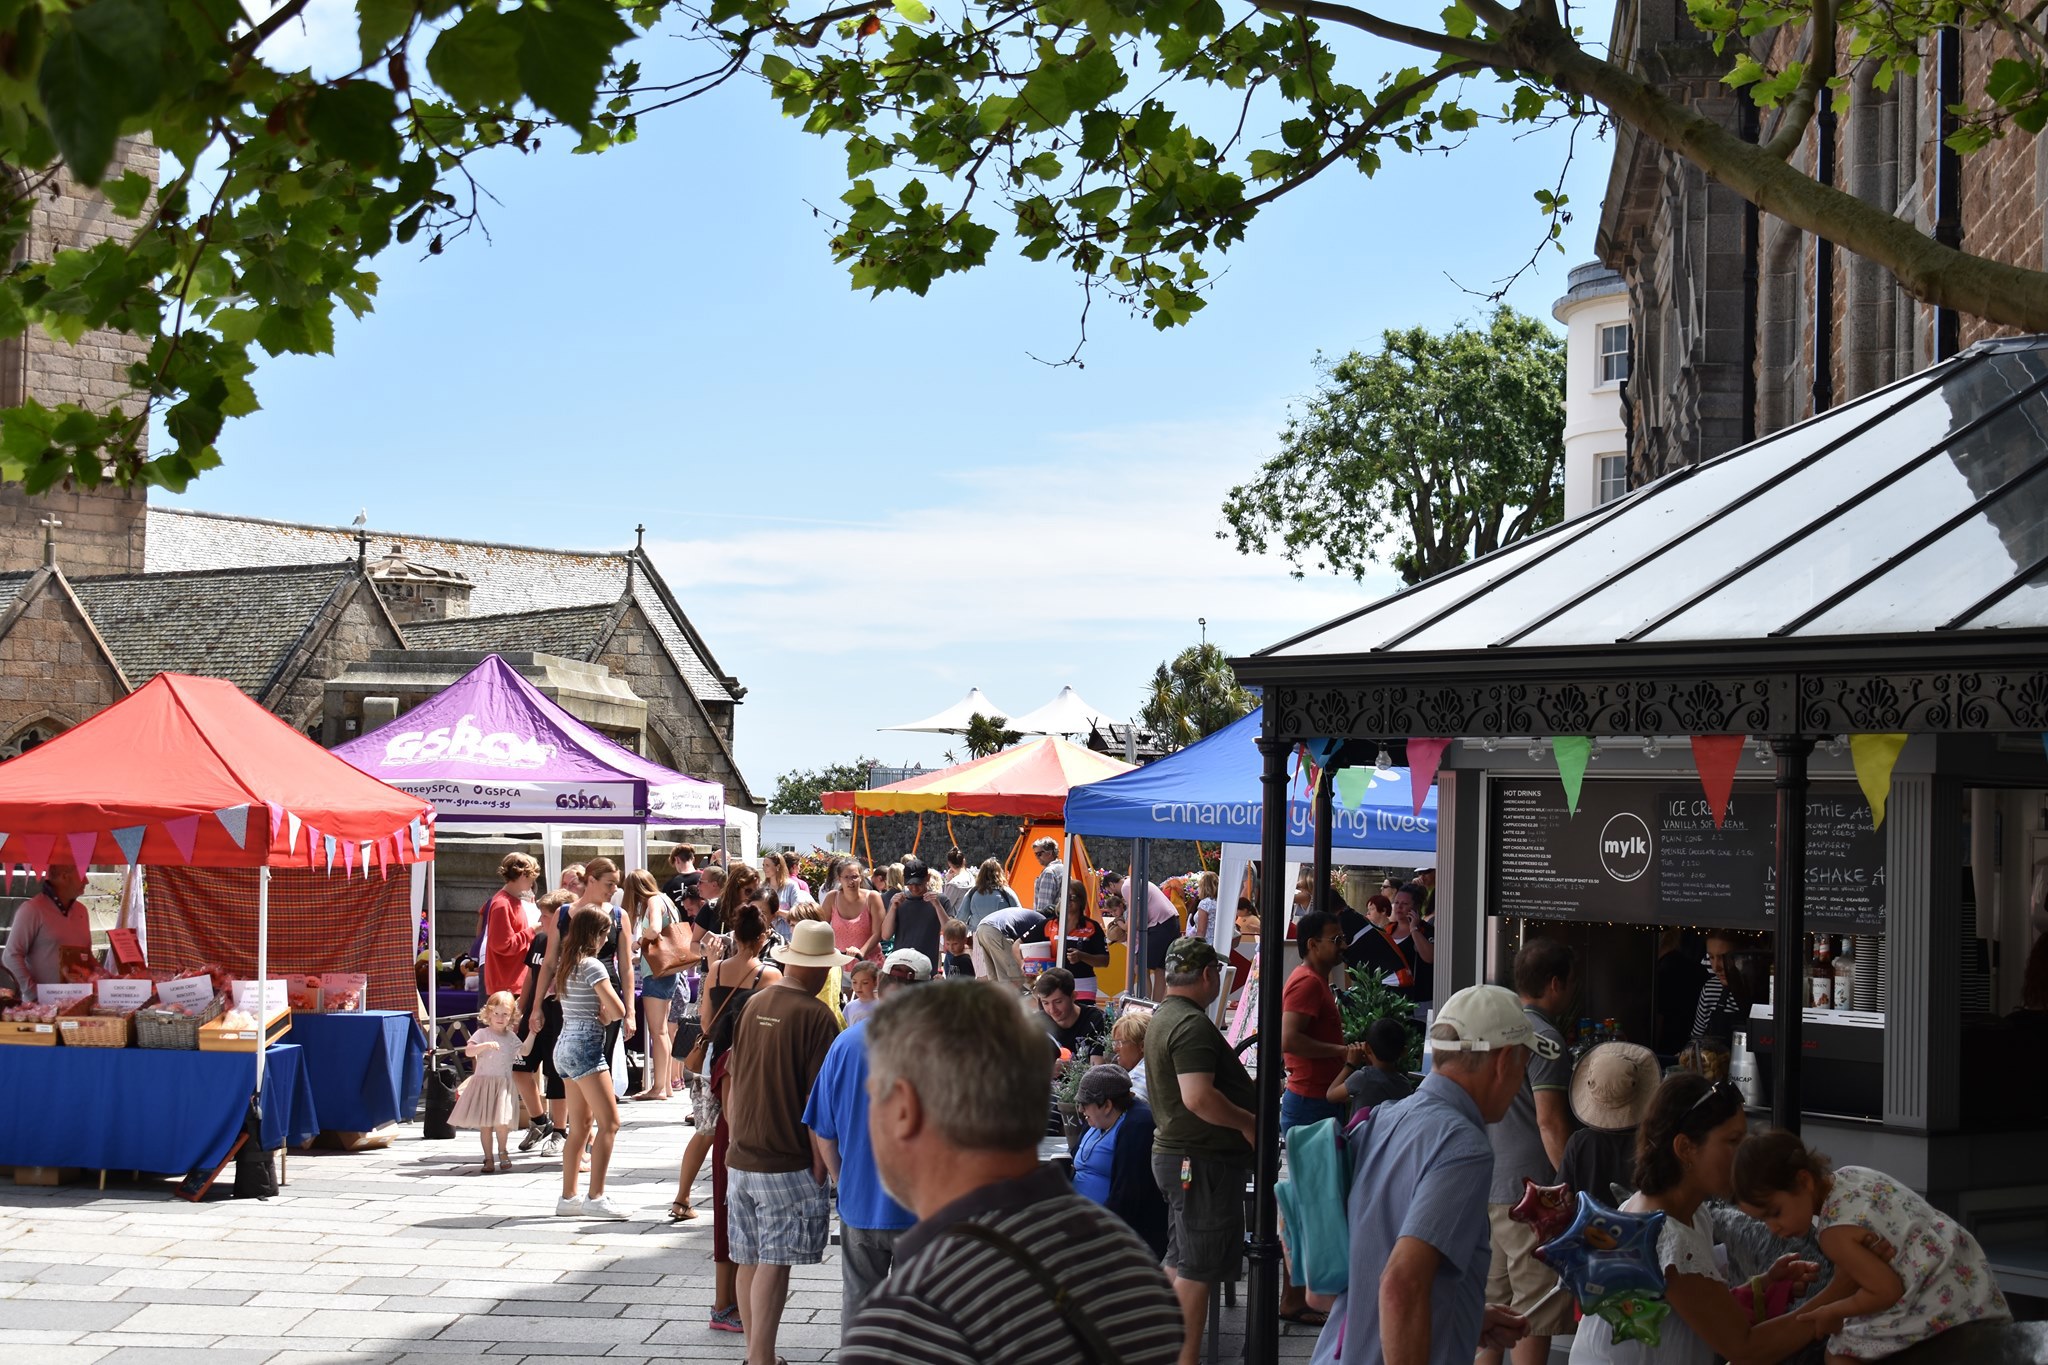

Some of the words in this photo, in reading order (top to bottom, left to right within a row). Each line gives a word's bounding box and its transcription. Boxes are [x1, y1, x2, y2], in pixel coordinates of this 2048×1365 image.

[397, 784, 460, 794] ernseySPCA
[484, 787, 521, 797] GSPCA
[555, 791, 612, 809] GSPCA
[1669, 800, 1687, 816] ICE
[1691, 800, 1734, 816] CREM
[1151, 799, 1262, 825] Enhancin
[1376, 809, 1429, 833] lives
[1663, 820, 1697, 829] VANILLA
[1604, 836, 1646, 858] mylk
[1661, 835, 1681, 843] PLAIN
